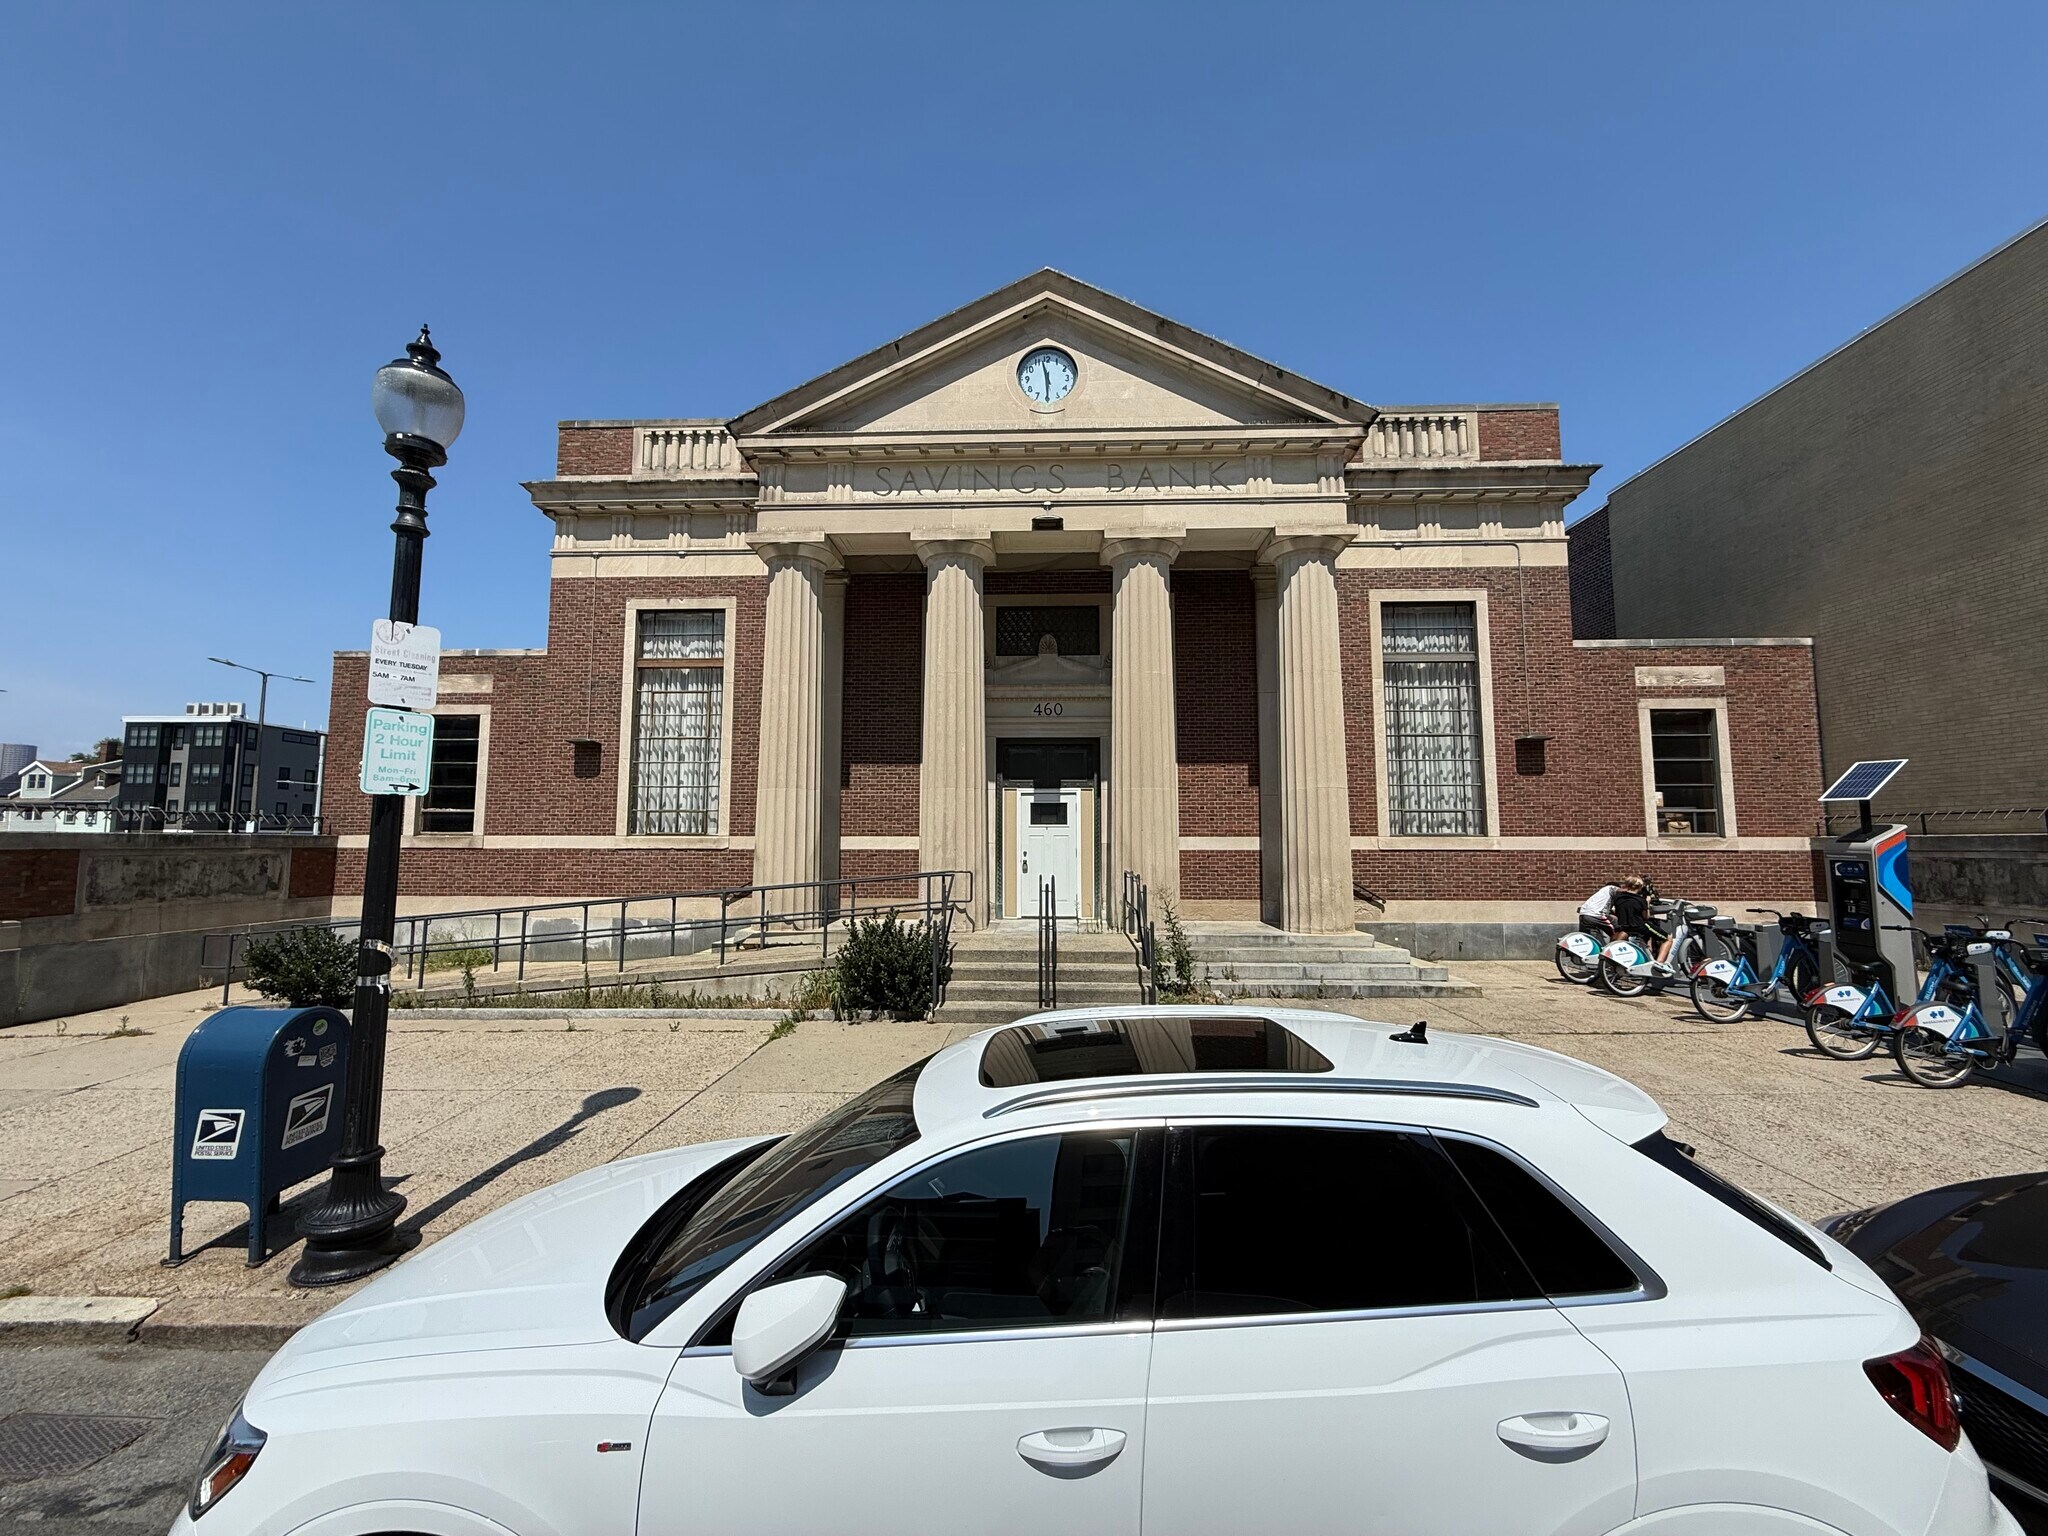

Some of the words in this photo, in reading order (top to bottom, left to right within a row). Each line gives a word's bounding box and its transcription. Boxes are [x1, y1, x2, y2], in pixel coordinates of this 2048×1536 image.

[1043, 355, 1051, 363] 12
[1025, 365, 1034, 373] 10
[1025, 375, 1030, 383] 9
[872, 464, 1066, 497] SAVINGS
[1105, 460, 1233, 493] BANK
[374, 645, 400, 657] Street
[403, 649, 436, 663] Cleaning
[375, 658, 397, 666] EVERY
[399, 661, 428, 671] TUESDAY
[372, 671, 390, 679] 5AM
[400, 674, 415, 682] 7AM
[1033, 702, 1063, 716] 460
[373, 718, 428, 736] Parking
[375, 733, 385, 745] 2
[389, 735, 424, 748] Hour
[380, 748, 417, 761] Limit
[378, 766, 417, 775] Mon-Fri
